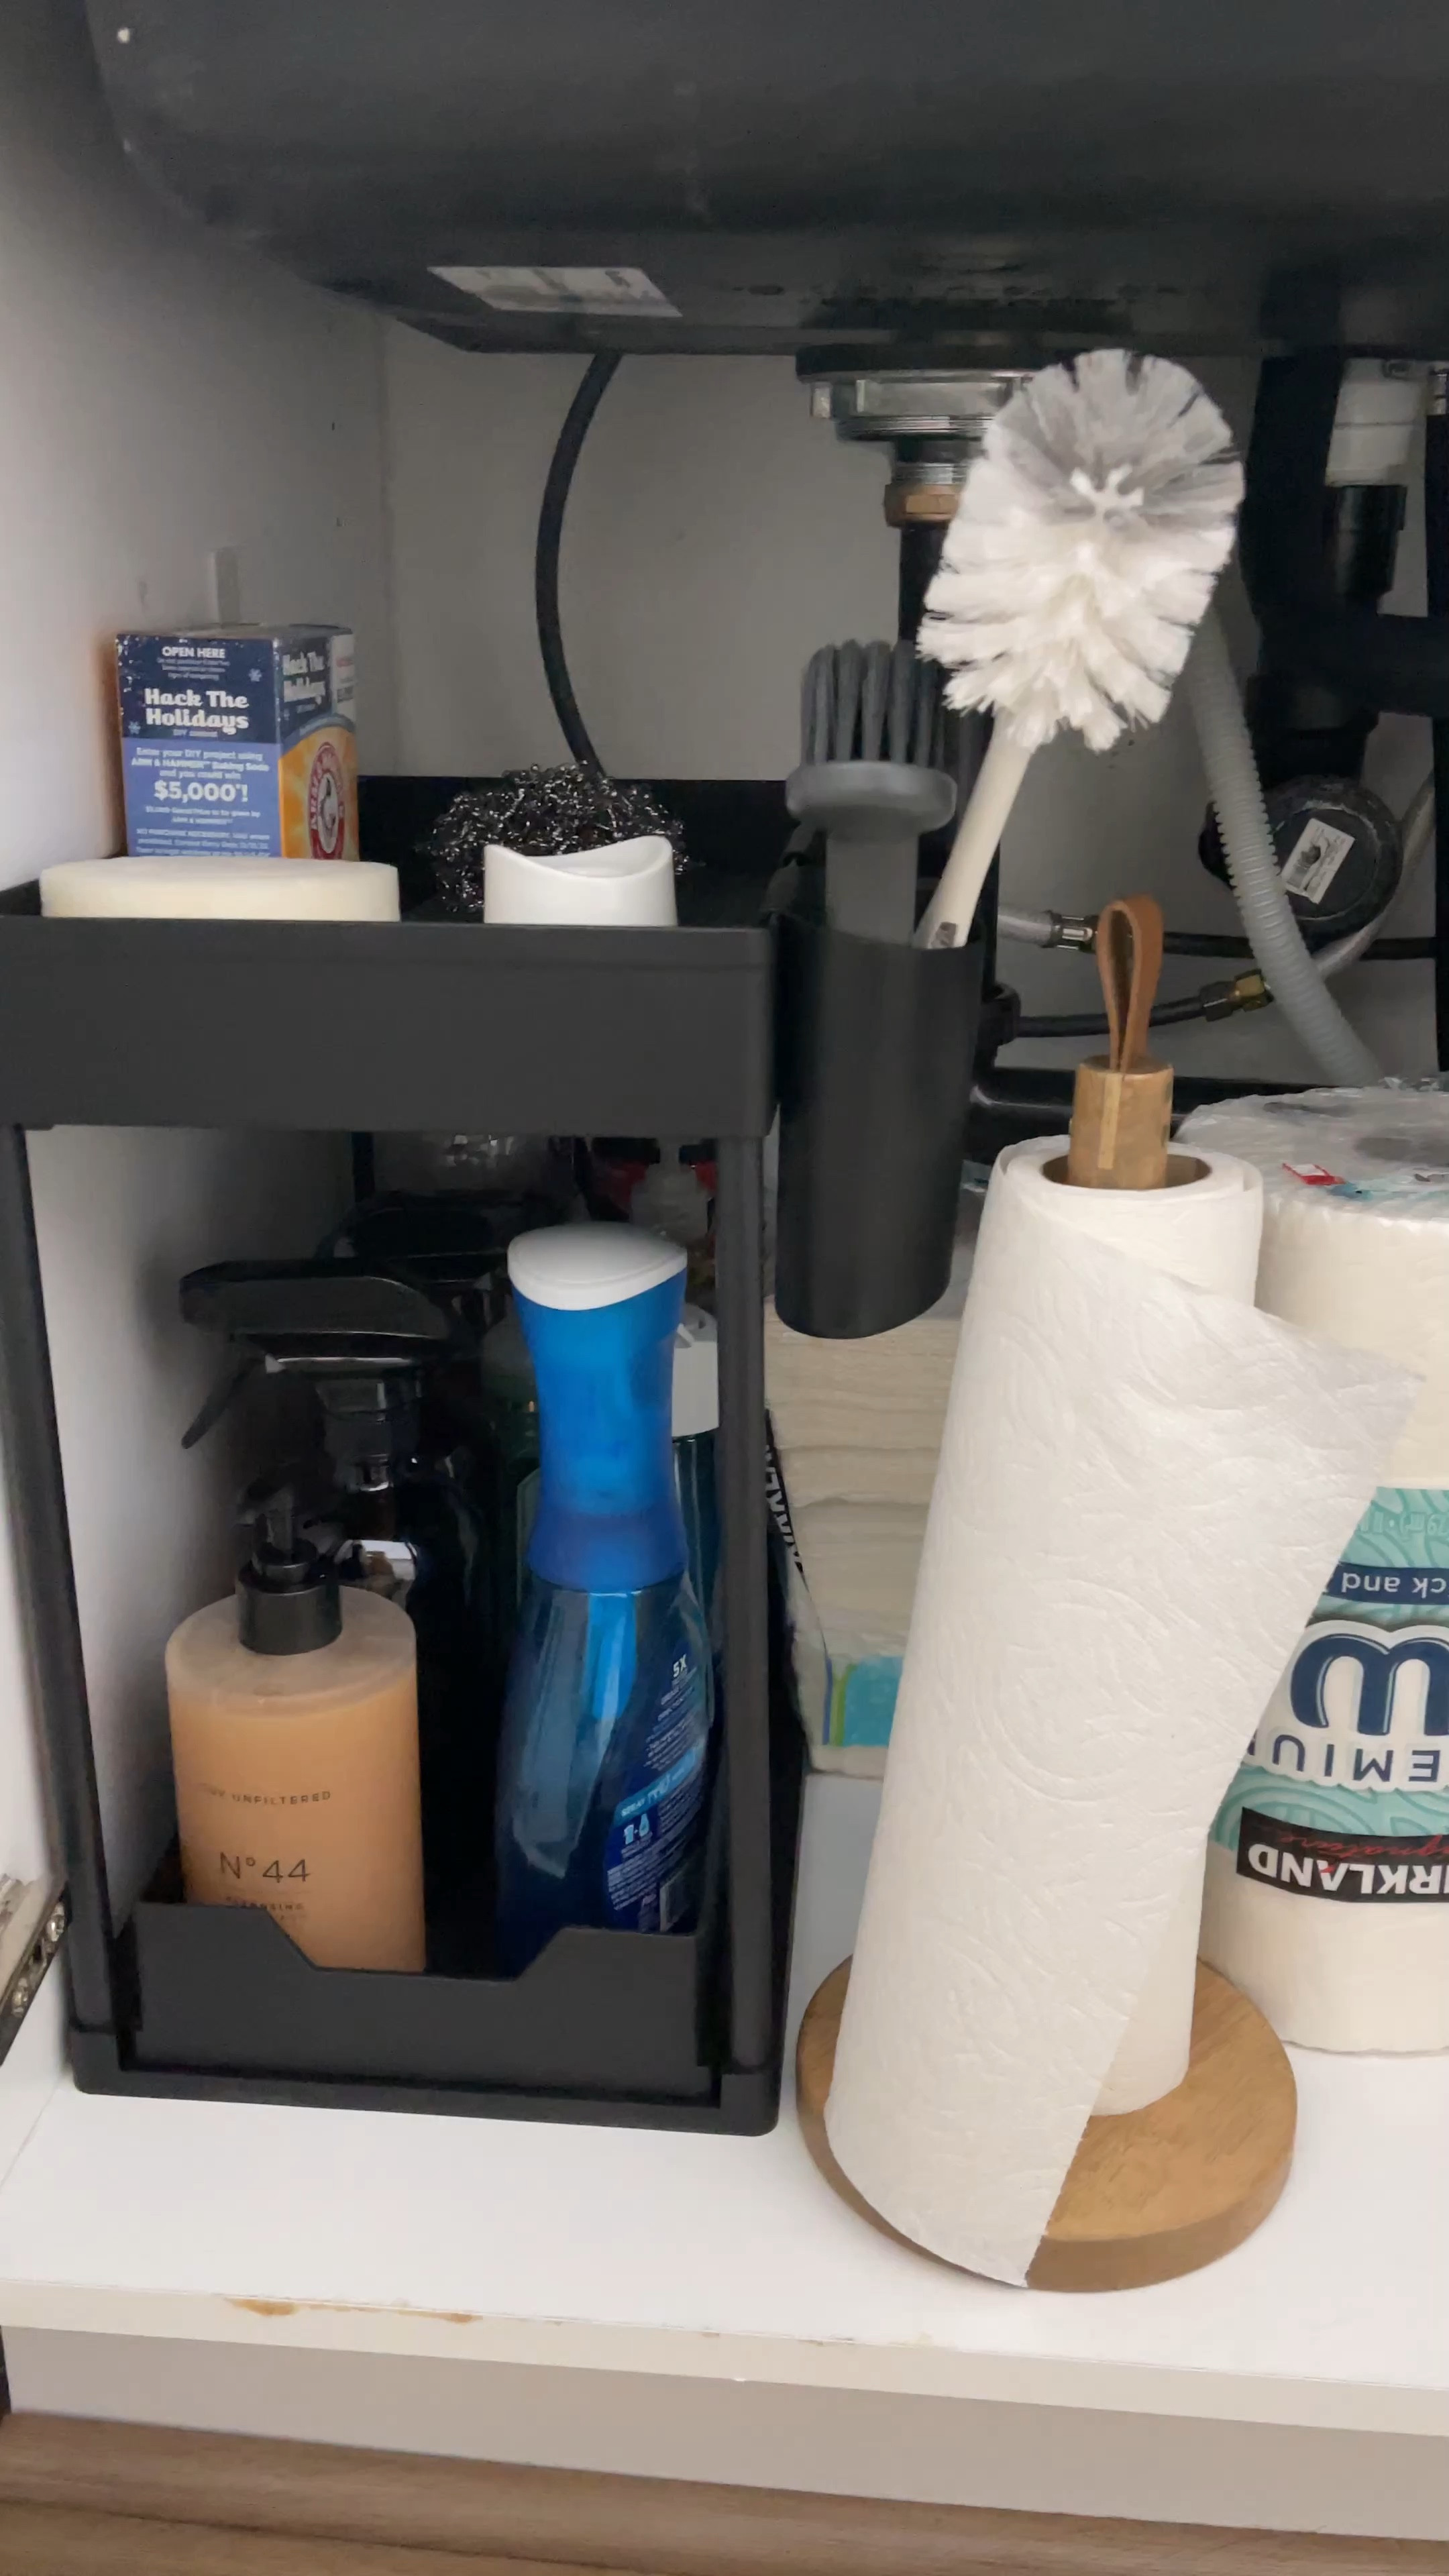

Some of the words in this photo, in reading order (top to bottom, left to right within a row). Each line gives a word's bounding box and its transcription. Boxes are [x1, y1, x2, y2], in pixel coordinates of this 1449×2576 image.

[162, 646, 195, 657] OPEN
[197, 647, 226, 658] HERE
[144, 688, 203, 706] Hack
[205, 690, 250, 708] The
[146, 708, 249, 735] Holidays
[1342, 1572, 1401, 1593] and
[1411, 1576, 1449, 1599] ck
[1247, 1729, 1441, 1782] EMIU
[232, 1790, 331, 1806] UNFILTERED
[1248, 1843, 1449, 1894] RKLAND
